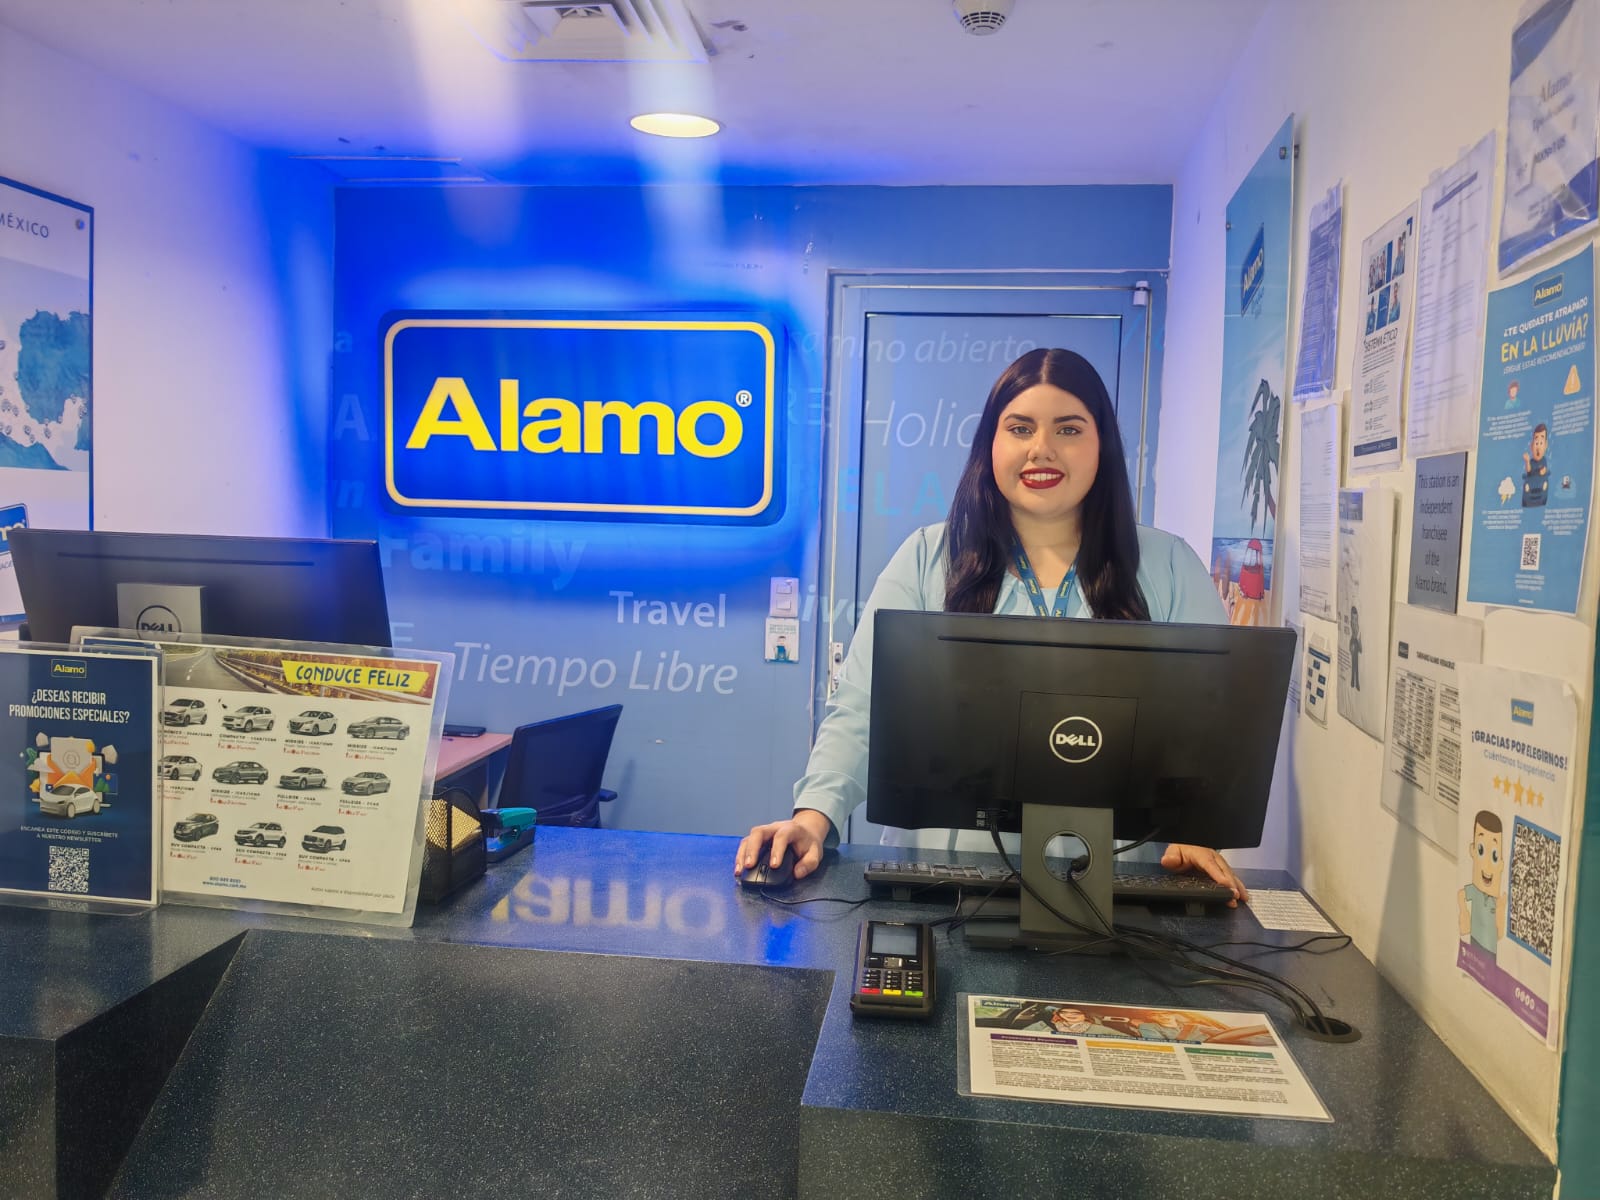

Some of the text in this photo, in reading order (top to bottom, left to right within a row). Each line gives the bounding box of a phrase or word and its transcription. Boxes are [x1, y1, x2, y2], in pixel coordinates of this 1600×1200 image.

[1534, 283, 1562, 301] Alamo
[1519, 312, 1553, 334] QUEDASTE
[1554, 296, 1588, 320] ATRAPADO
[1501, 340, 1519, 363] EN
[1523, 335, 1538, 357] LA
[1418, 474, 1428, 489] This
[1428, 473, 1446, 489] station
[1419, 499, 1453, 518] independent
[1421, 523, 1448, 541] franchisee
[379, 523, 588, 592] Family
[1415, 574, 1430, 592] Alamo
[609, 589, 727, 629] Travel
[53, 663, 85, 674] Alamo
[296, 665, 411, 688] CONDUCE FELIZ
[454, 640, 739, 697] Tiempo Libre
[31, 688, 106, 705] ¿DESEAS RECIBIR
[9, 704, 130, 724] PROMOCIONES ESPECIALES?
[1055, 733, 1097, 747] DELL
[1471, 729, 1568, 771] ¡GRACIAS POR ELEGIRNOS!
[1483, 748, 1516, 769] Cuéntanos
